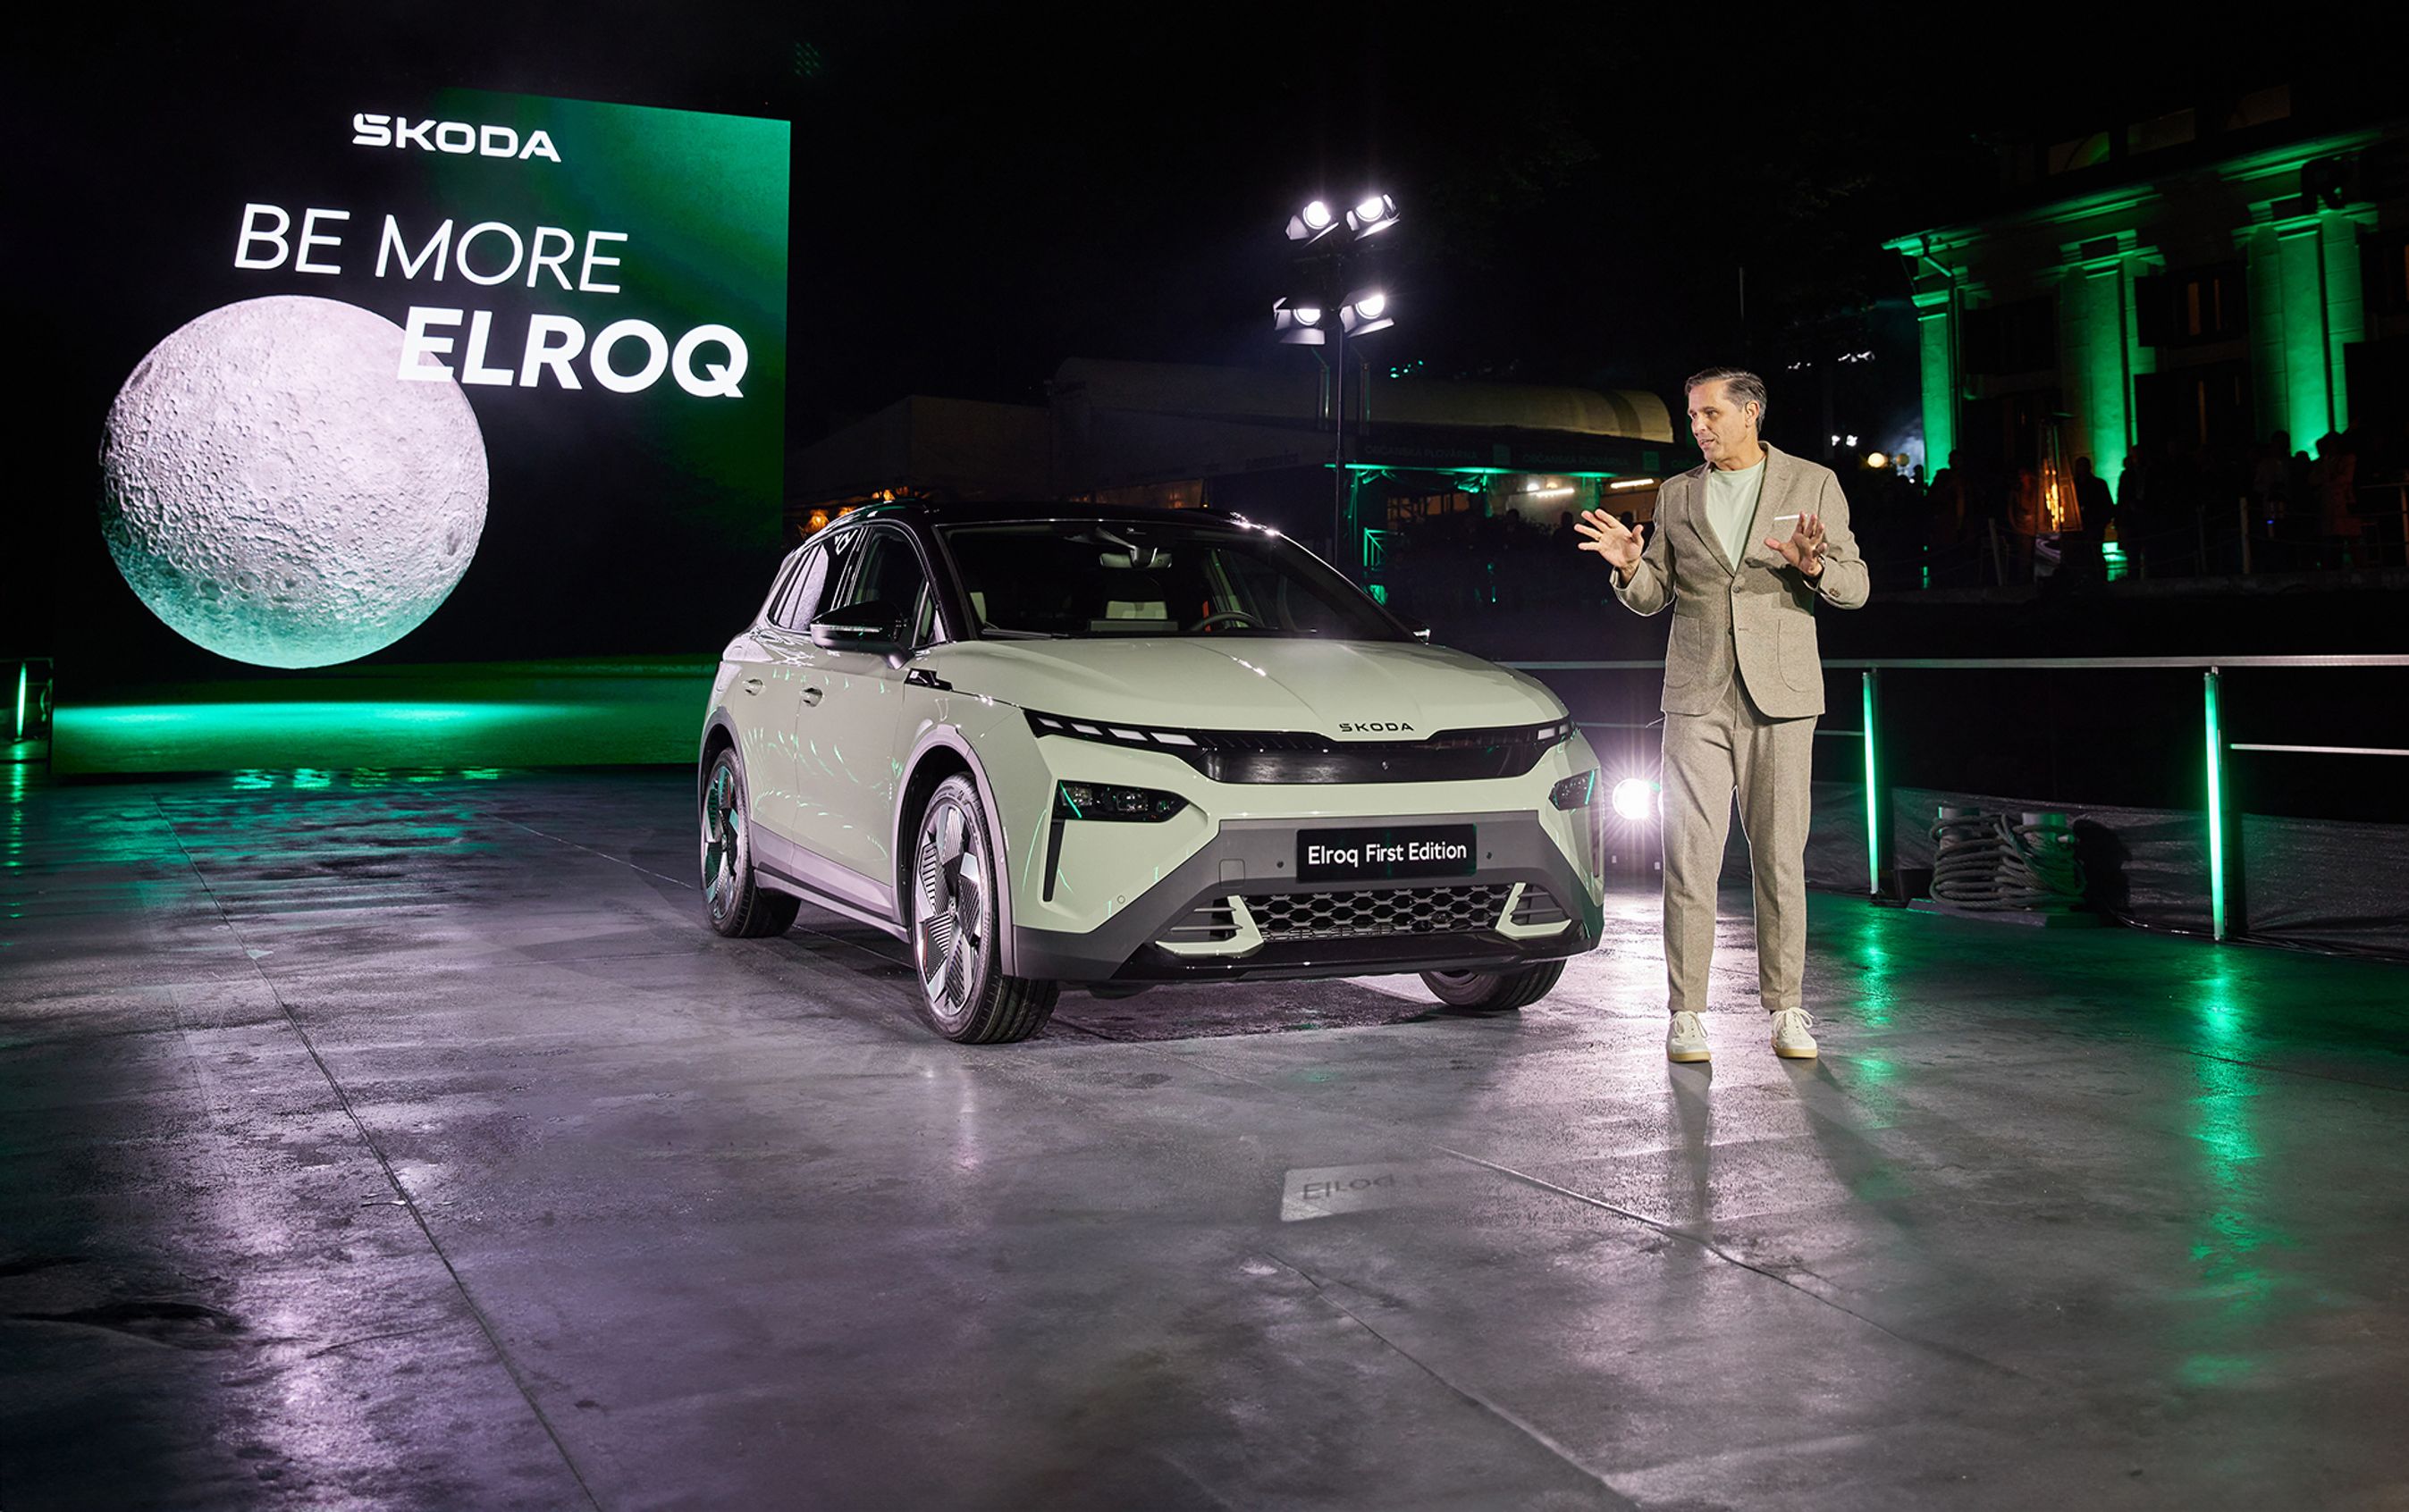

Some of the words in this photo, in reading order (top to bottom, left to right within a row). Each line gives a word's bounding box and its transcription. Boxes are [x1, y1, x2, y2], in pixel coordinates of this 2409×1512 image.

[234, 203, 350, 275] BE
[375, 214, 628, 294] MORE
[397, 306, 749, 399] ELROQ
[1308, 844, 1359, 868] Elroq
[1366, 843, 1404, 862] First
[1409, 841, 1467, 861] Edition
